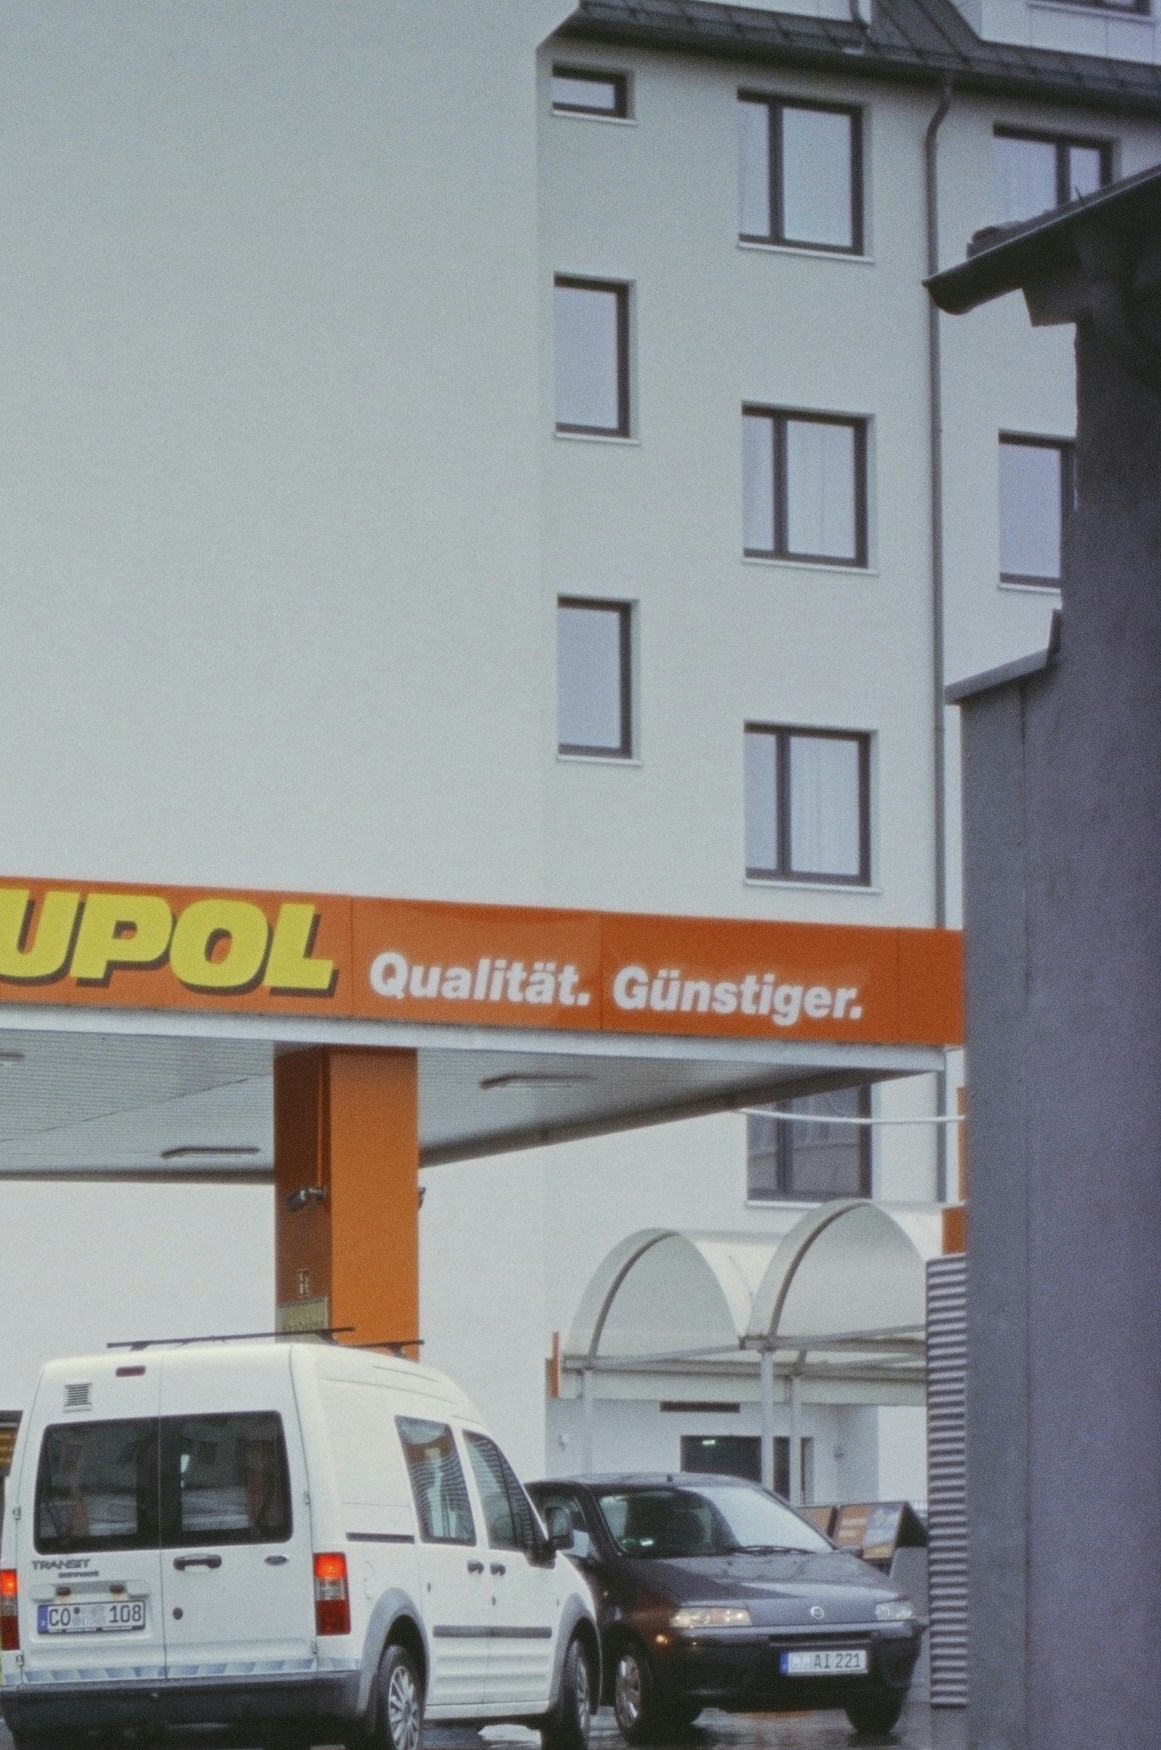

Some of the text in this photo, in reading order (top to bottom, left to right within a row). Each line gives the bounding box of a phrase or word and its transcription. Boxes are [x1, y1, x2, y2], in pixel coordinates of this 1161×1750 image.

[370, 951, 863, 1026] Qualität. Günstiger.
[32, 1558, 91, 1570] TRANSIT
[48, 1604, 142, 1627] CO 108
[835, 1653, 861, 1668] 221
